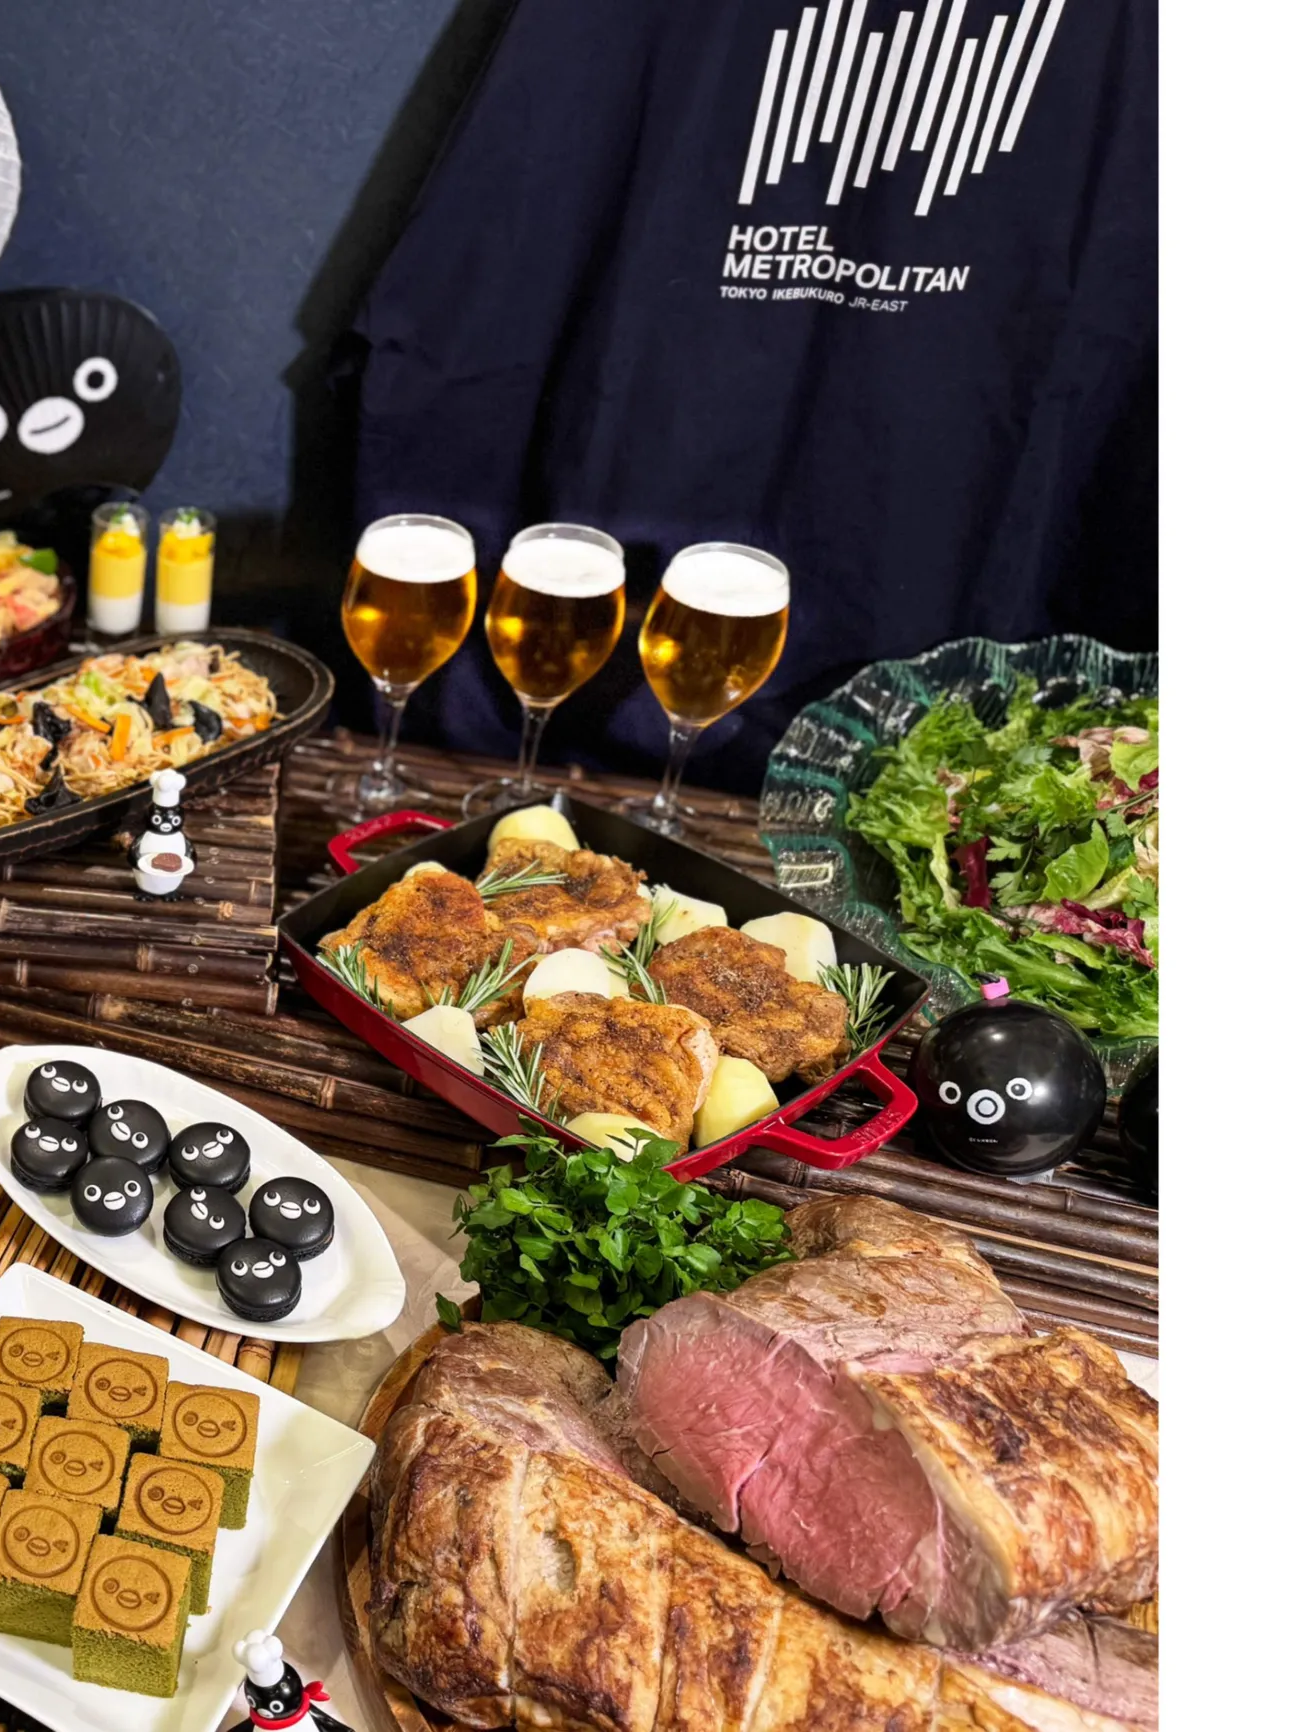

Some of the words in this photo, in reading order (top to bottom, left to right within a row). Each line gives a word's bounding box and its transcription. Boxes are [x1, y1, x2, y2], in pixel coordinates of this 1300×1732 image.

[728, 225, 834, 251] HOTEL
[722, 253, 970, 292] METROPOLITAN
[720, 286, 767, 300] TOKYO
[772, 287, 844, 304] IKEBUKURO
[849, 297, 908, 312] JR-EAST
